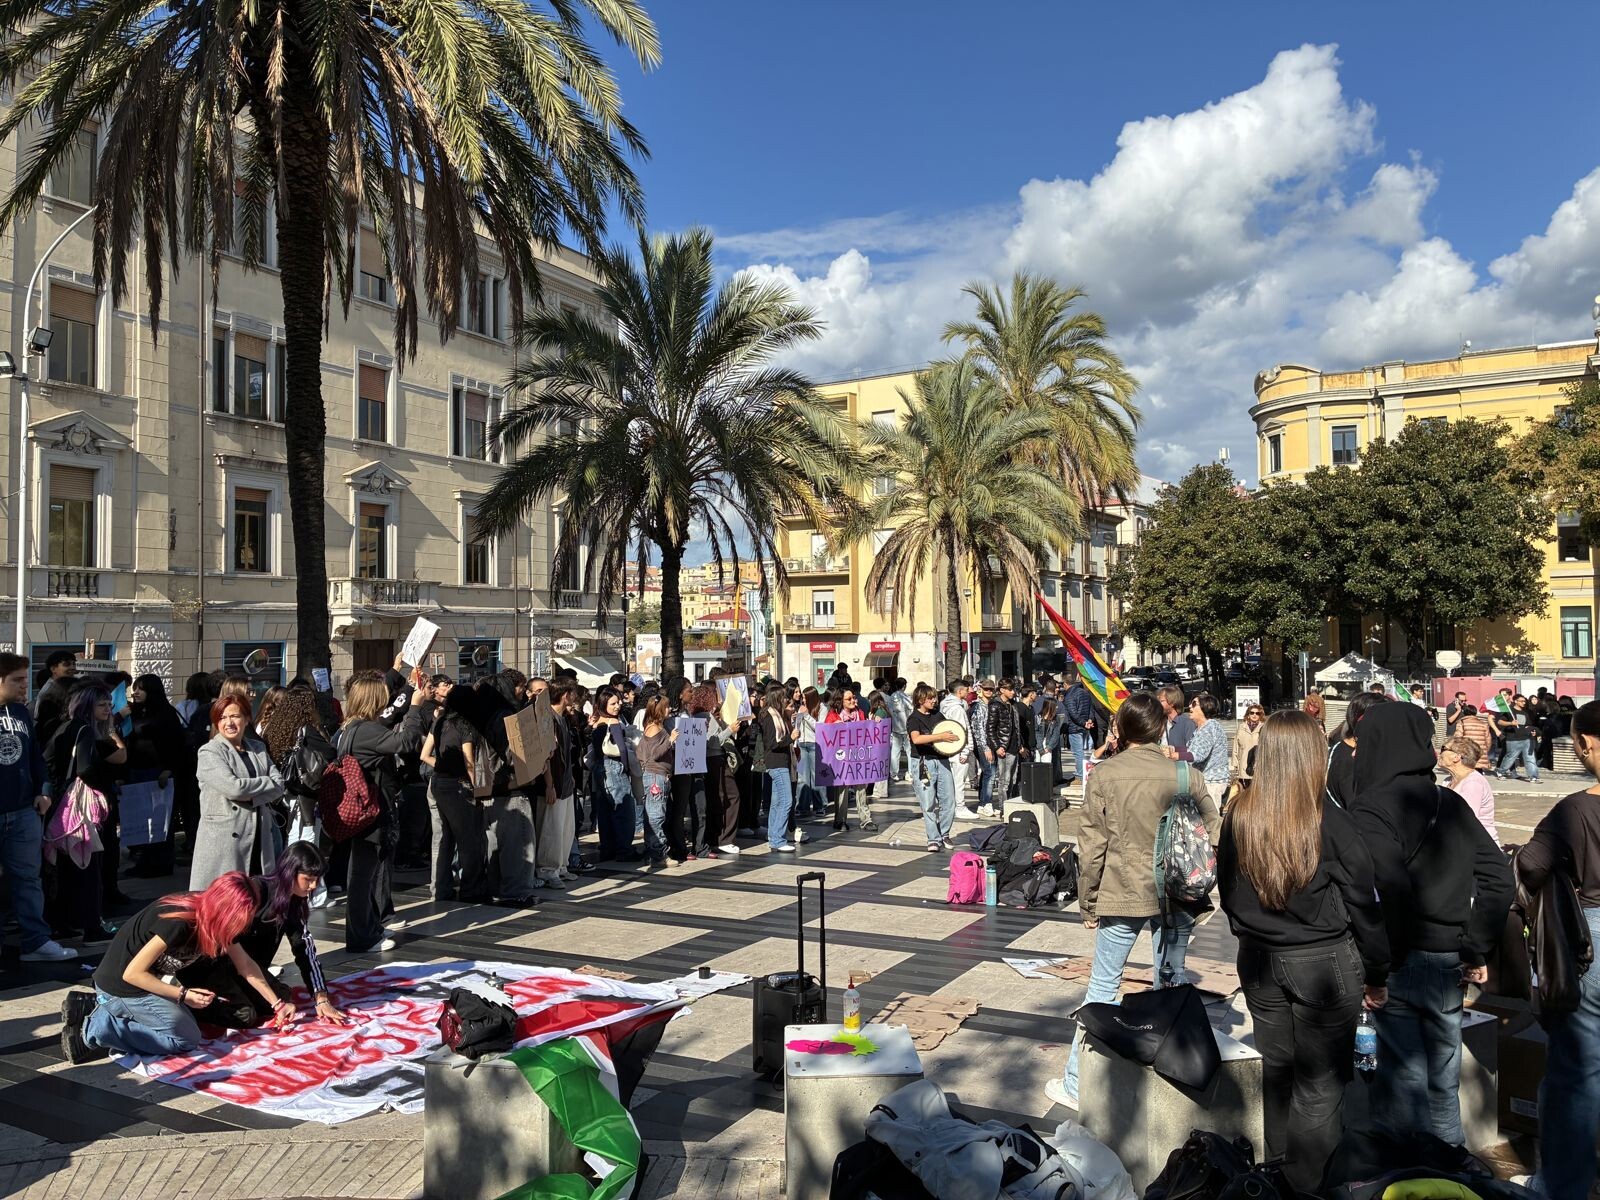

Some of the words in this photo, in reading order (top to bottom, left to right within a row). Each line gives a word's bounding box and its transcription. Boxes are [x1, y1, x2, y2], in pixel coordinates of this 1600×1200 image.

[821, 725, 888, 747] WELFARE
[848, 746, 873, 760] NOT
[829, 759, 889, 780] WARFARE
